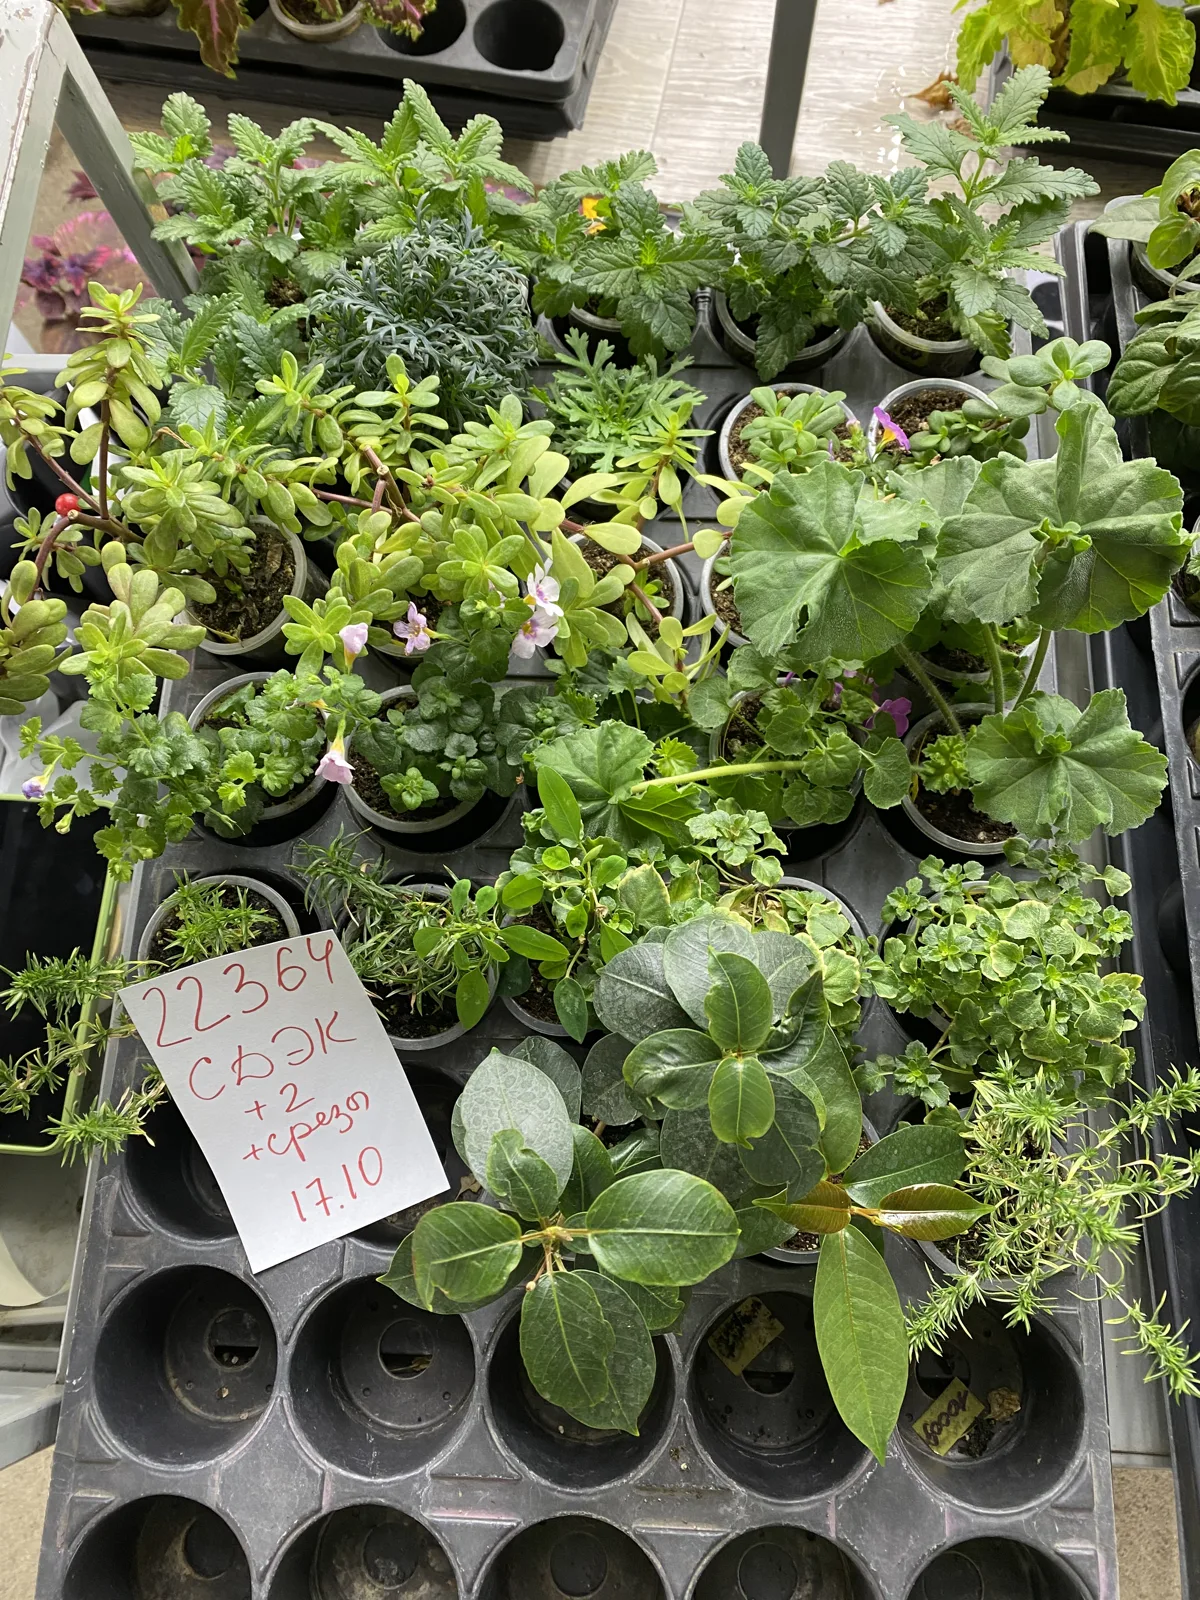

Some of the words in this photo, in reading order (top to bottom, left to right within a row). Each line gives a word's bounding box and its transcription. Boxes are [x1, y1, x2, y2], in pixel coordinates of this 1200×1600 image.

[142, 937, 334, 1048] 22364
[188, 1010, 357, 1101] СДЭК
[290, 1146, 383, 1222] 17.10
